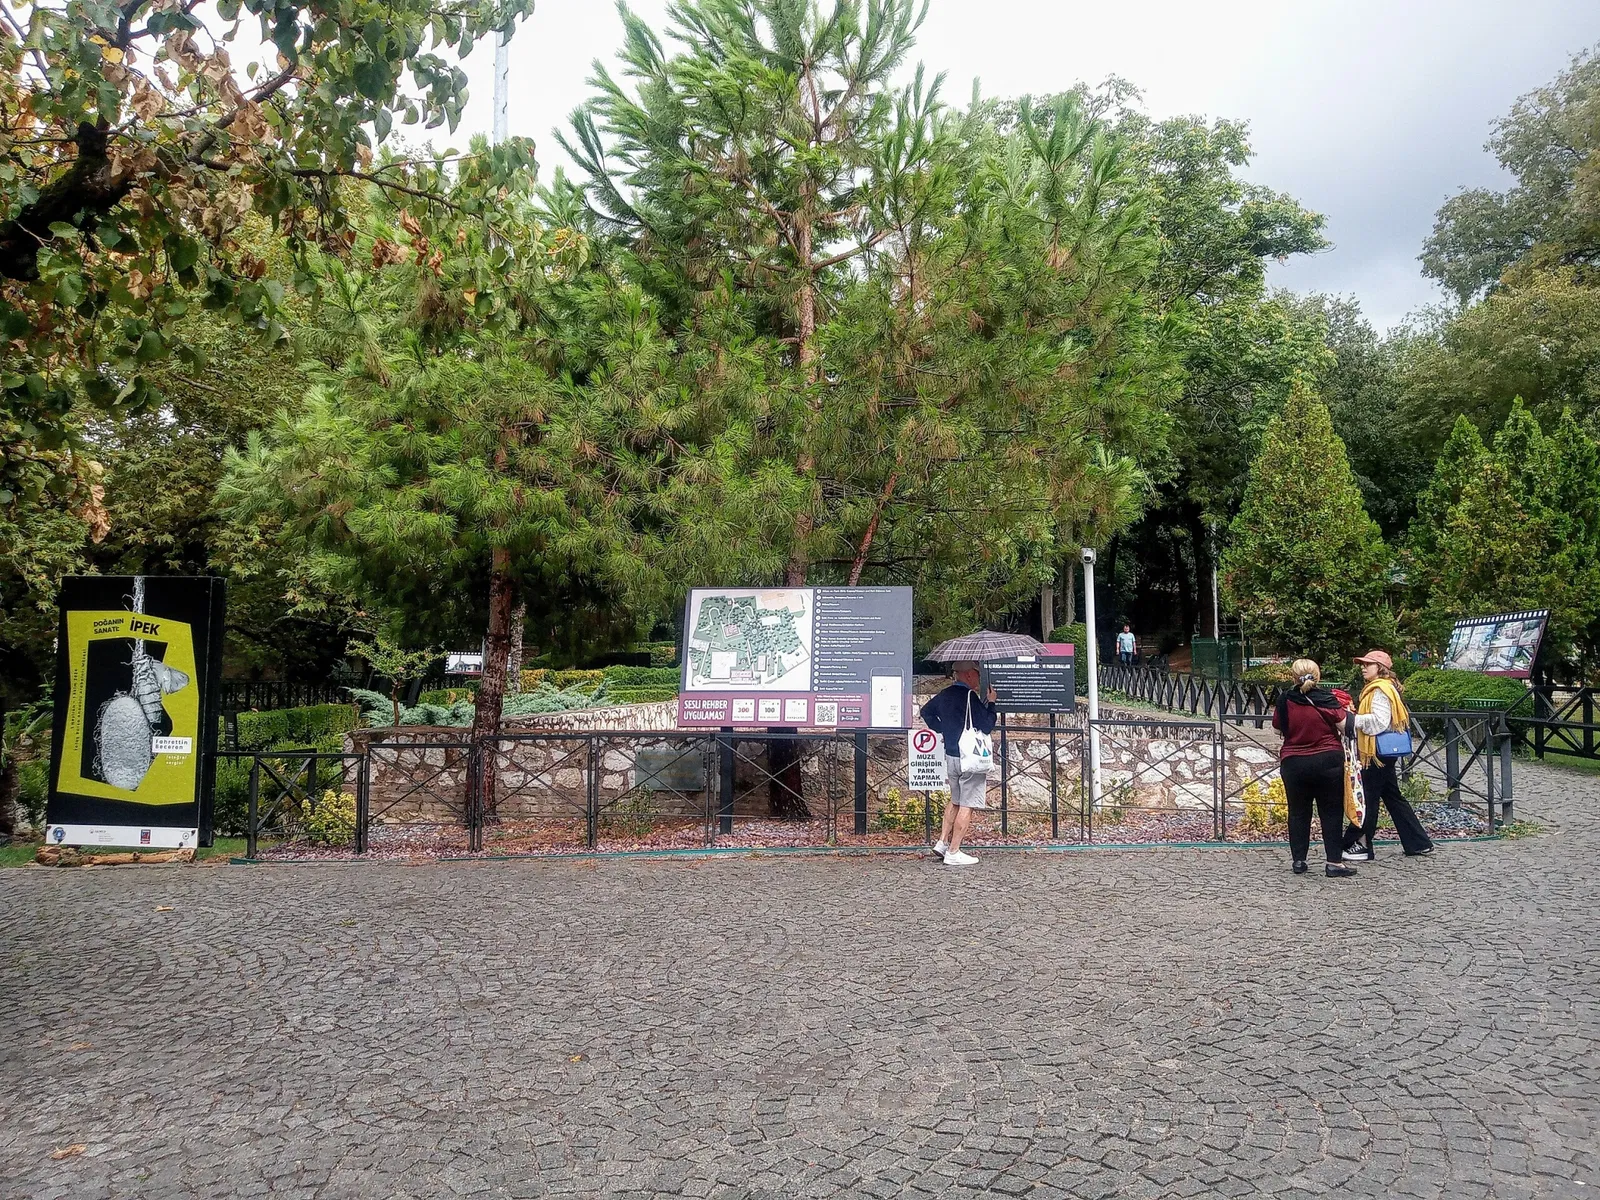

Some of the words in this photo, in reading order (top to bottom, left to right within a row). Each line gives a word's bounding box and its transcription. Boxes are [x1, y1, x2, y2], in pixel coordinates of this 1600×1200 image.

[93, 618, 124, 627] DOĞANIN
[129, 616, 161, 636] İPEK
[702, 700, 728, 709] REHBER
[683, 710, 726, 721] UYGULAMASI
